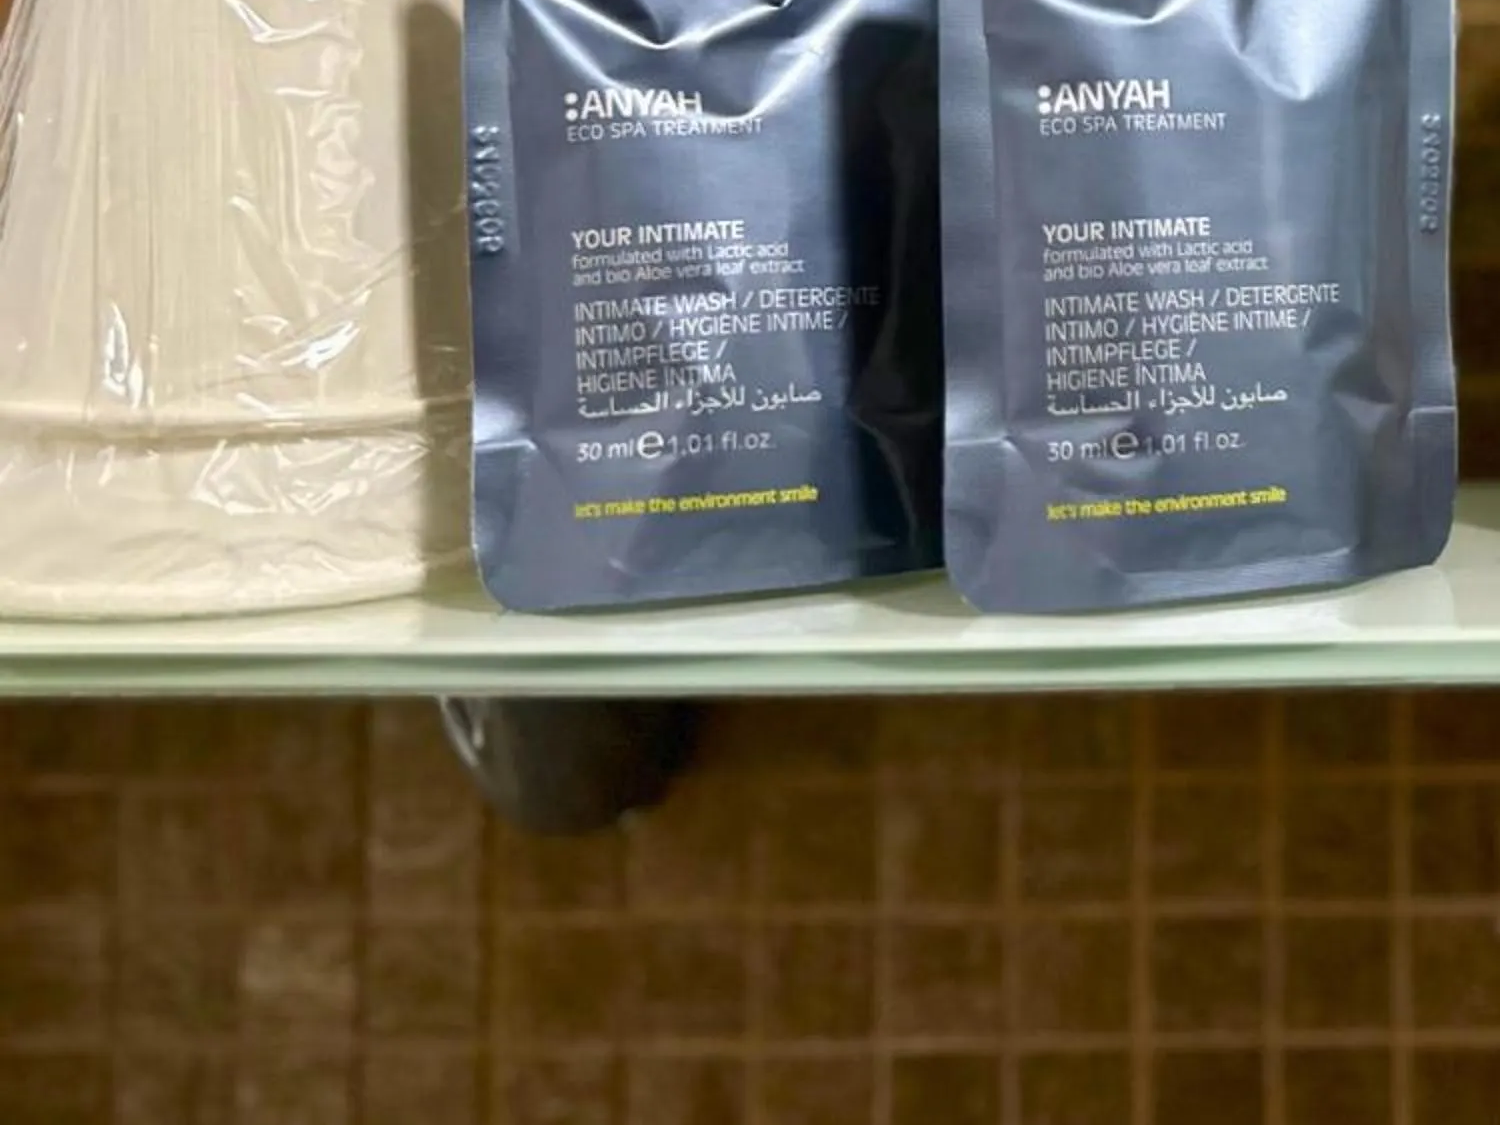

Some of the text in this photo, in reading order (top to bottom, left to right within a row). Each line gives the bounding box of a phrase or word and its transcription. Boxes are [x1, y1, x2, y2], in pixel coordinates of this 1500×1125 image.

[566, 118, 762, 142] ECO SPA TREATMENT
[1039, 112, 1226, 135] ECO SPA TREATMENT
[571, 220, 744, 249] YOUR INTIMATE
[1043, 217, 1210, 245] YOUR INTIMATE
[572, 242, 788, 270] formulated with Lactic acid
[1043, 240, 1253, 265] formulated with Lactic acid
[572, 258, 804, 286] and bio Aloe vera leaf extract
[1043, 256, 1269, 282] and bio Aloe vera leaf extract
[574, 296, 667, 322] INTIMATE
[675, 290, 736, 315] WASH
[1045, 292, 1139, 317] INTIMATE
[1145, 288, 1203, 311] WASH
[1225, 283, 1340, 307] DETERGENTE
[575, 322, 646, 346] INTIMO
[767, 310, 833, 332] INTIME
[1045, 318, 1119, 342] INTIMO
[1234, 308, 1297, 331] INTIME
[576, 341, 709, 371] INTIMPFLEGE
[1046, 339, 1181, 367] INTIMPFLEGE
[576, 362, 736, 395] HIGIENE INTIMA
[1046, 362, 1207, 392] HIGIENE INTIMA
[751, 383, 822, 412] صابون
[1219, 382, 1288, 412] صابون
[607, 438, 635, 459] ml
[667, 433, 713, 456] 1.01
[1081, 438, 1107, 460] ml
[1144, 433, 1186, 456] 1.01
[648, 496, 676, 514] the
[679, 490, 776, 512] environment
[779, 483, 819, 503] smile
[1124, 498, 1152, 515] the
[1154, 491, 1246, 513] environment
[1249, 485, 1287, 505] smile
